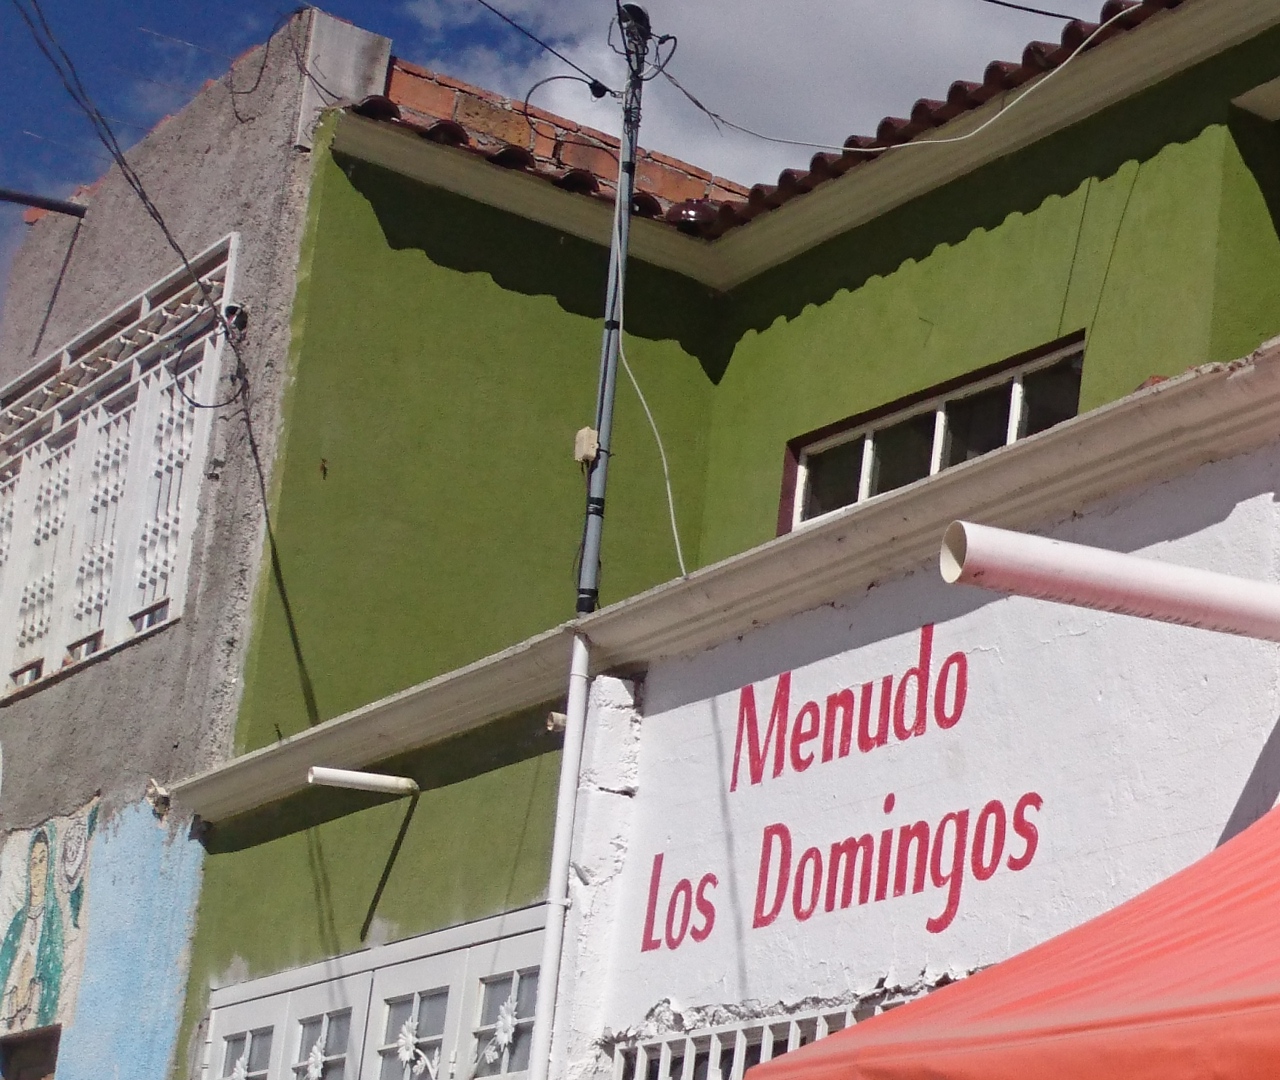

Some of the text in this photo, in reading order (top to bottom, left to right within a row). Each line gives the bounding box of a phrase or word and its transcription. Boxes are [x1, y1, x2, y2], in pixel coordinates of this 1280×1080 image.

[731, 624, 968, 791] Menudo
[642, 792, 1042, 951] Los Domingos
